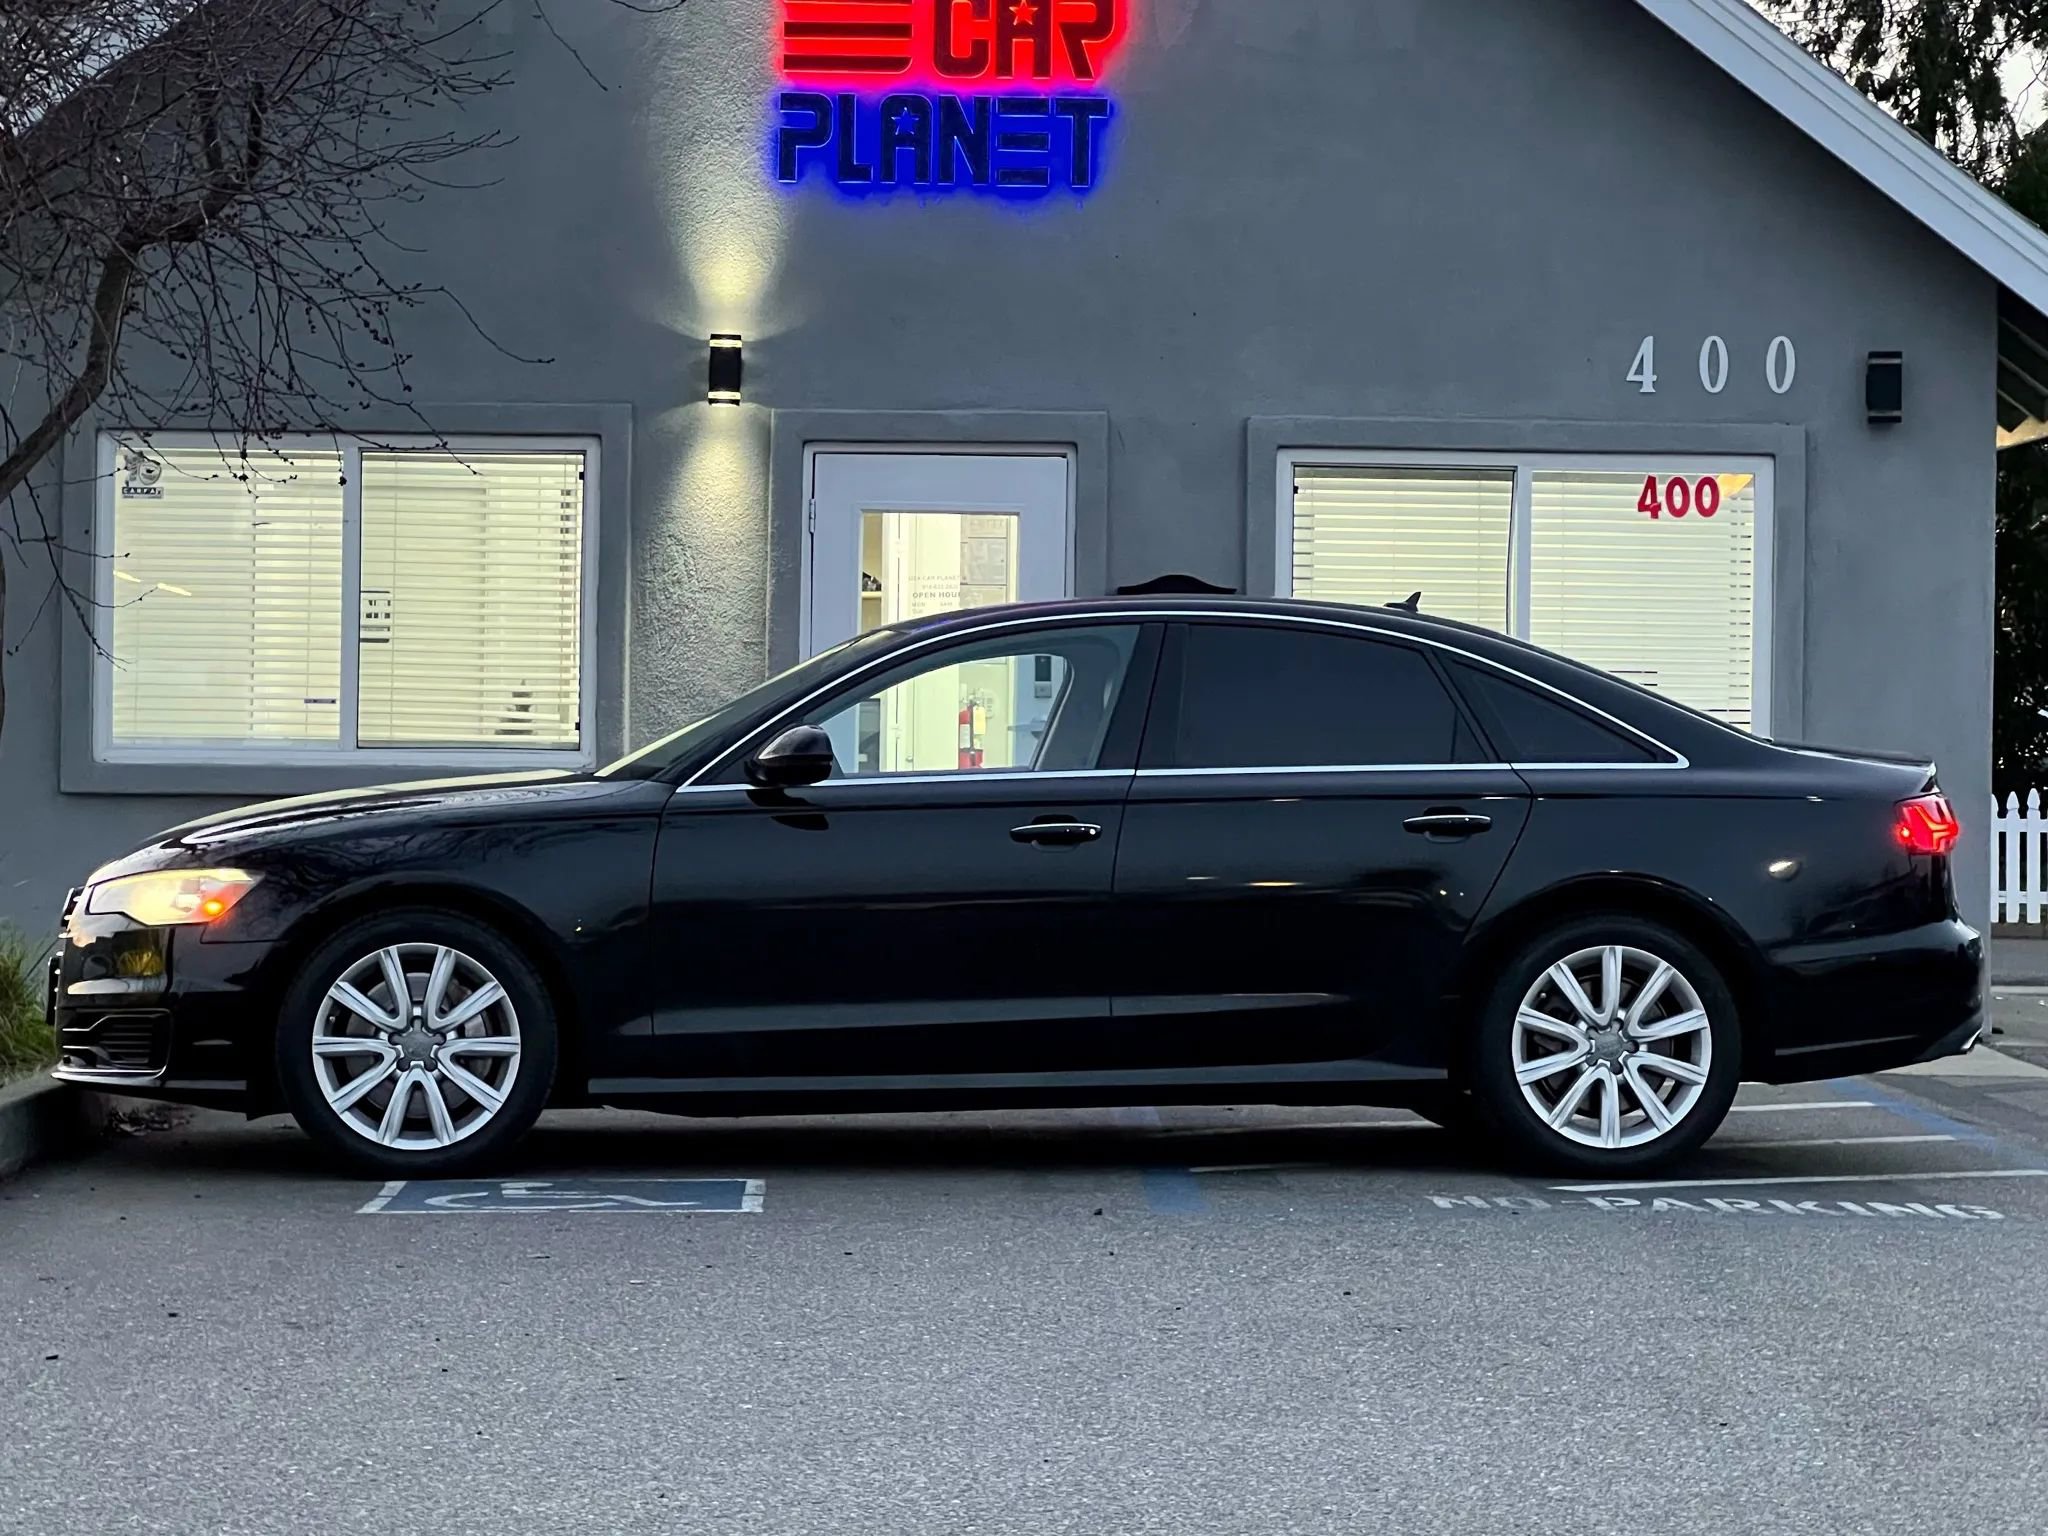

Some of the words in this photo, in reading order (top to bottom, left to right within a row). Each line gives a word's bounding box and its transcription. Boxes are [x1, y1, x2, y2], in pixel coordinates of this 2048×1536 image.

[932, 0, 1115, 81] CAR
[778, 92, 1110, 188] PLANET
[1626, 335, 1796, 394] 400
[1637, 474, 1720, 519] 400
[912, 591, 936, 599] OPEN
[1584, 1196, 2004, 1219] PARKING
